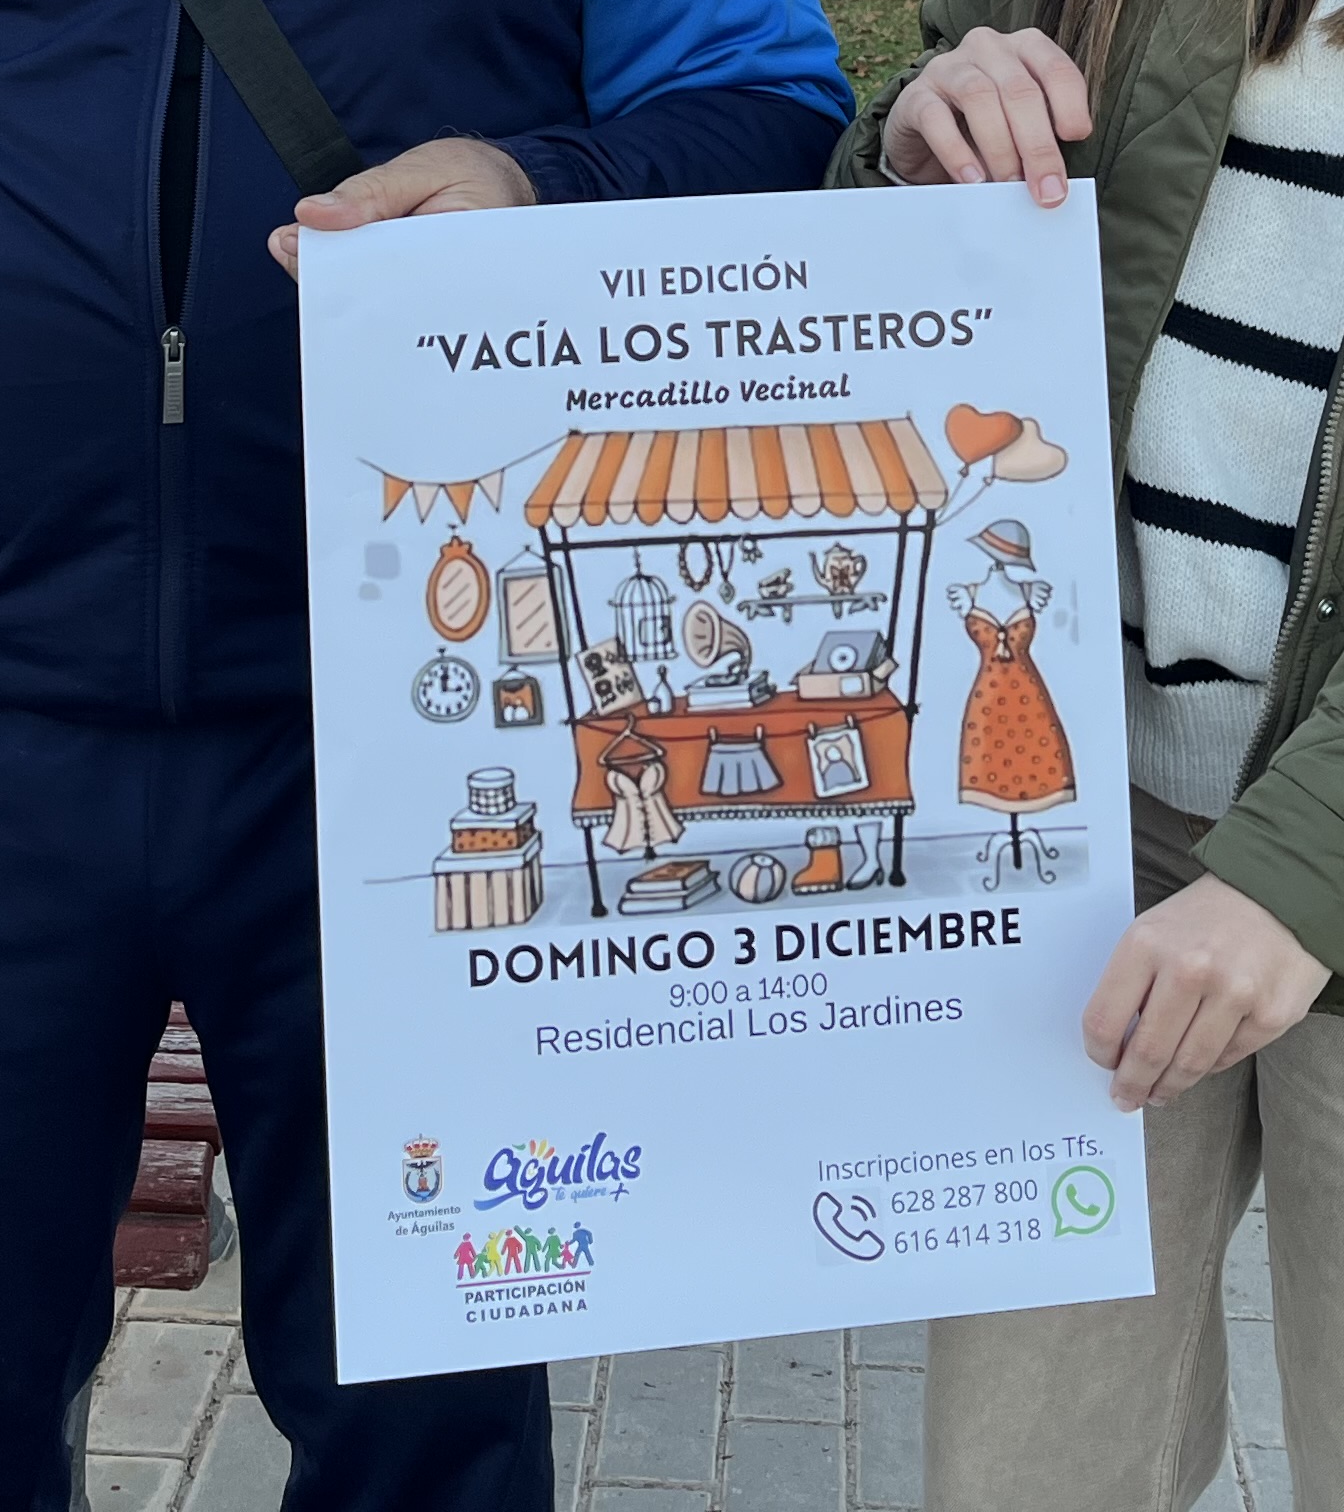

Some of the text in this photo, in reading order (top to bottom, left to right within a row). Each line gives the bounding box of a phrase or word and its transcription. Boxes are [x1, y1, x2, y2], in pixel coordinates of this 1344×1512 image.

[600, 254, 807, 299] VII EDICIÓN
[600, 323, 689, 363] LOS
[566, 373, 850, 411] Mercadillo Vecinal
[467, 906, 1023, 988] DOMINGO 3 DICIEMBRE
[668, 972, 829, 1008] 9:00 a 14:00
[536, 995, 963, 1056] Residencial Los Jardines
[819, 1135, 1103, 1182] Inscripciones en los Tfs.
[570, 1184, 608, 1204] quiere
[892, 1179, 1037, 1214] 628 287 800
[387, 1204, 461, 1222] Ayuntamiento
[396, 1221, 454, 1236] de Águilas
[895, 1218, 1040, 1254] 616 414 318
[464, 1279, 586, 1305] PARTICIPACIÓN
[465, 1298, 588, 1323] CIUDADANA
